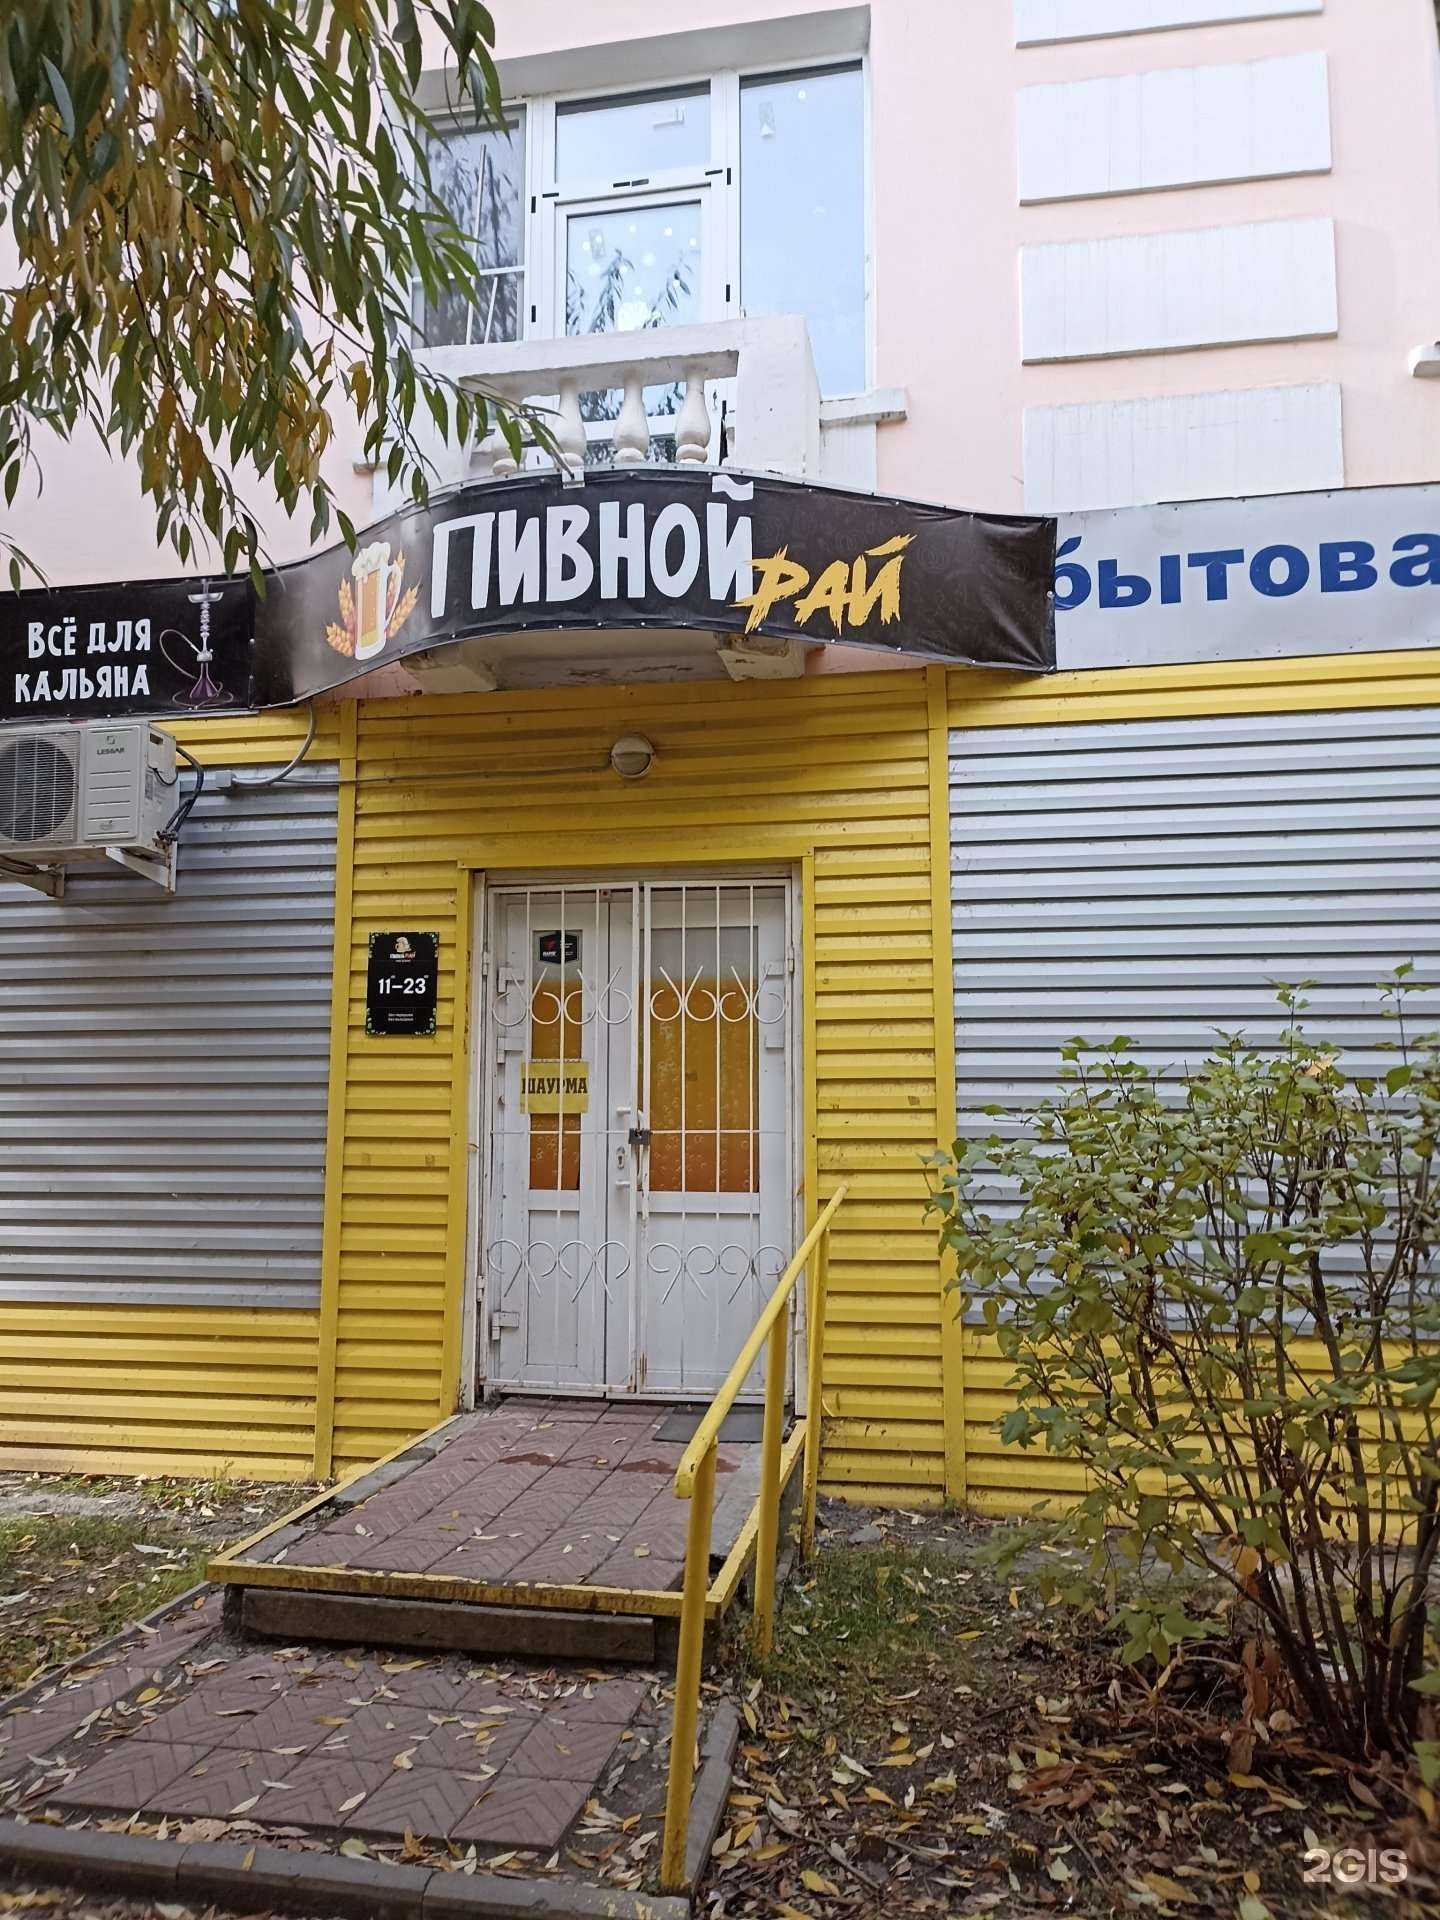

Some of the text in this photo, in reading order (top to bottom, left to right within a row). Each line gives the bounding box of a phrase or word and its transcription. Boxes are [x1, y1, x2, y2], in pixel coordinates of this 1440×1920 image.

[431, 475, 917, 634] ПИВНОЙ РАЙ
[1054, 532, 1440, 611] бытова
[28, 616, 151, 659] ВСЁ ДЛЯ
[15, 664, 151, 703] КАЛЬЯНА
[521, 1077, 588, 1094] ШАУРМА
